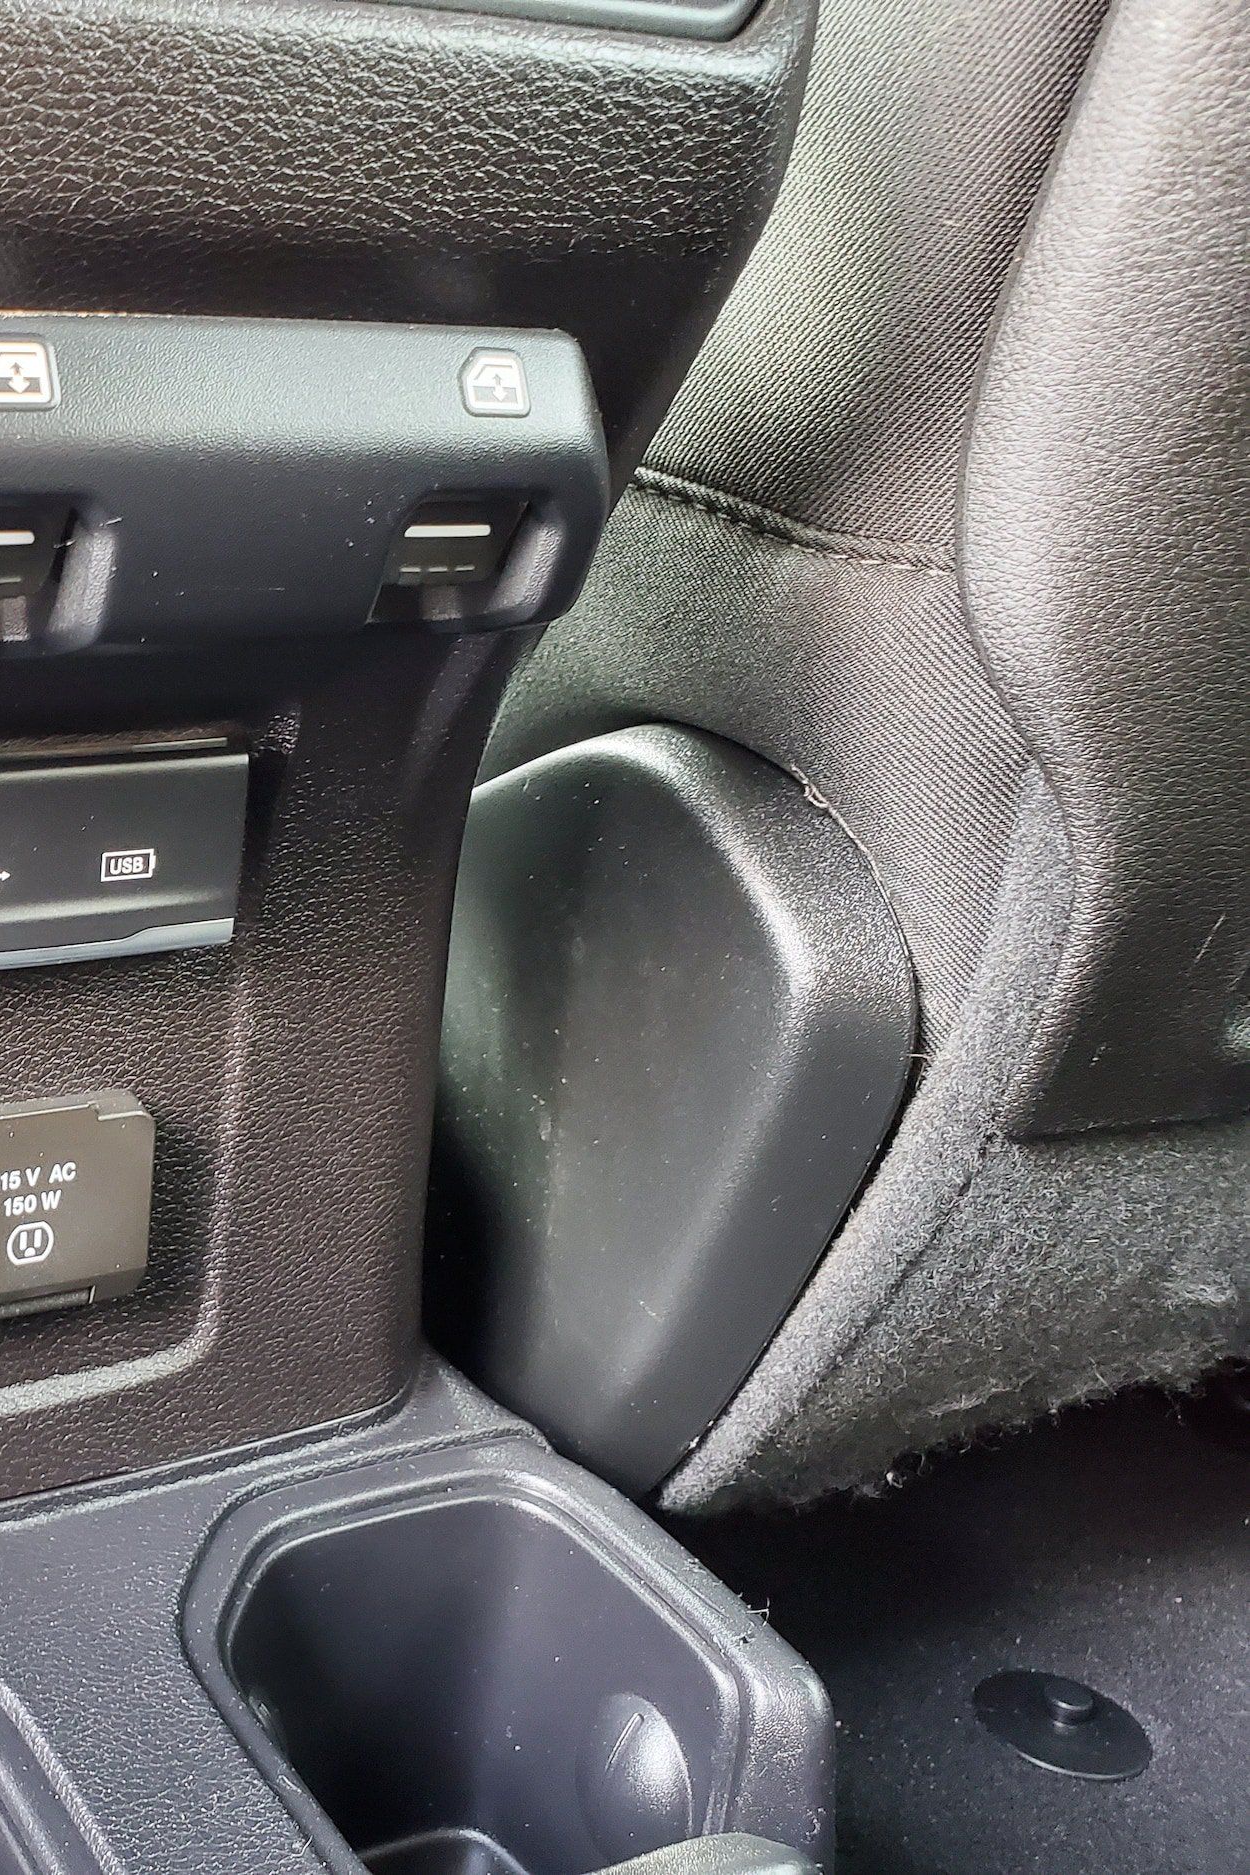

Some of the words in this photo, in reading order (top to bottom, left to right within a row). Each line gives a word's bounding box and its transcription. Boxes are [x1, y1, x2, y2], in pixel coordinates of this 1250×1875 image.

[109, 857, 144, 875] USB
[25, 1166, 41, 1186] V
[49, 1162, 76, 1184] AC
[3, 1194, 37, 1216] 150
[41, 1189, 62, 1211] W
